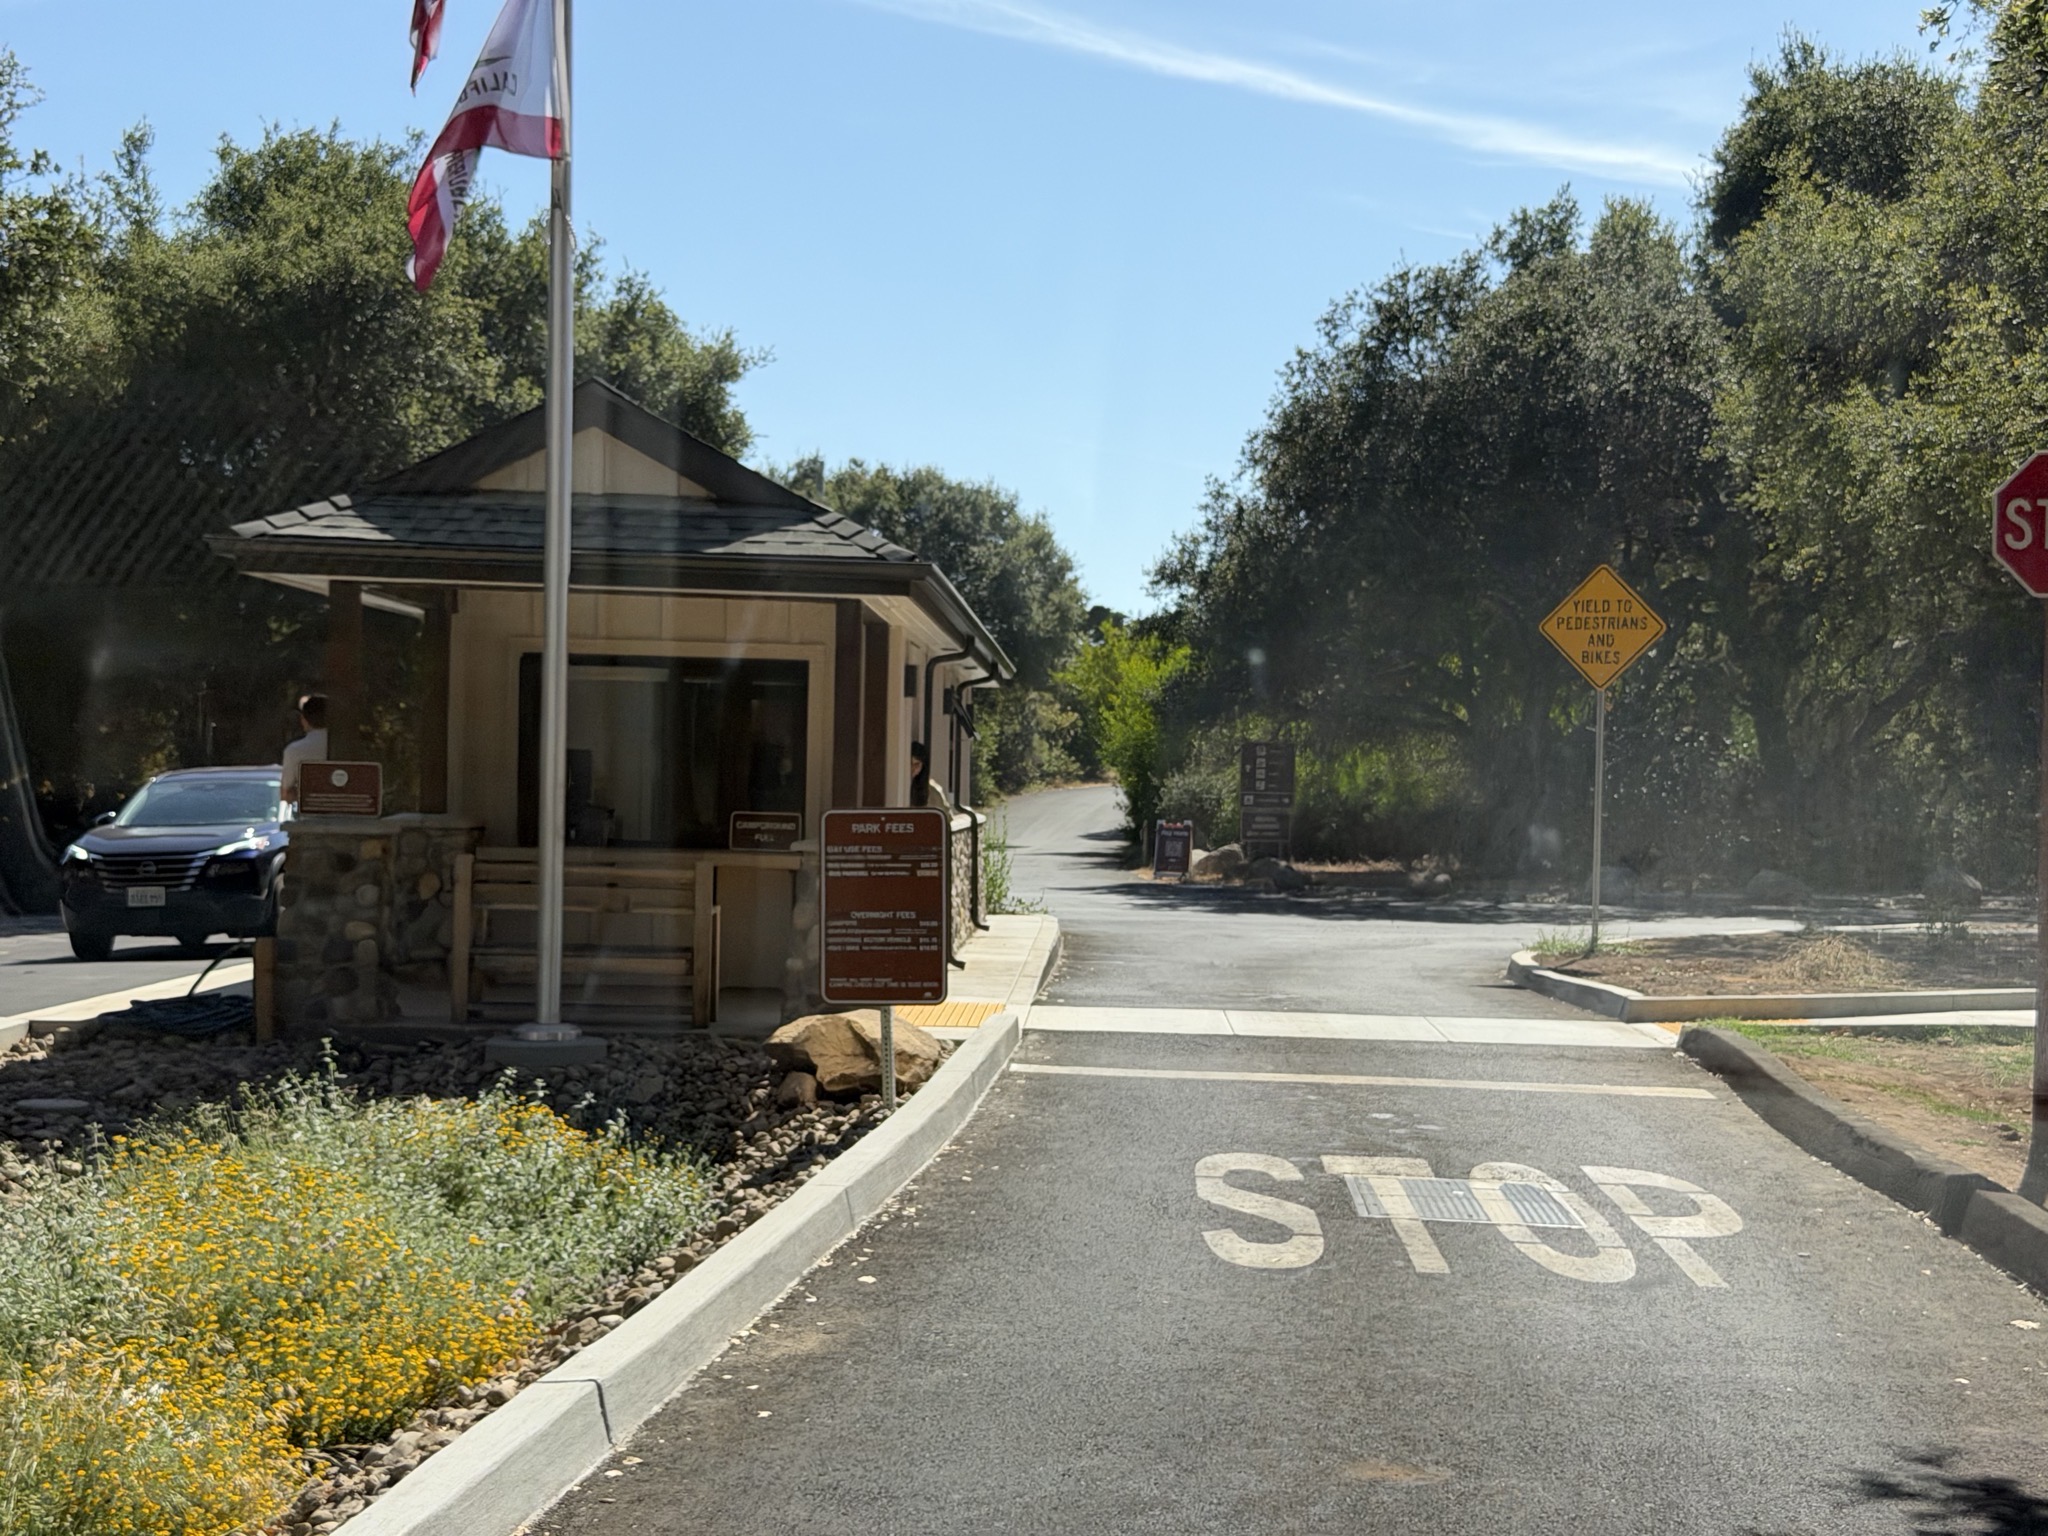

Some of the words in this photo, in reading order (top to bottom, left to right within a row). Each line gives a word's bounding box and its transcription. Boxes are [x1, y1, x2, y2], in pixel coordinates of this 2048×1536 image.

[1573, 599, 1611, 613] YIELD
[1617, 599, 1633, 613] TO
[1556, 616, 1648, 630] PEDESTRIANS
[1587, 633, 1615, 647] AND
[1581, 650, 1620, 664] BIKES
[851, 823, 881, 834] PARK
[885, 823, 915, 834] FEES
[850, 911, 894, 919] OVERNIGHT
[896, 911, 917, 919] FEES
[1194, 1152, 1743, 1288] STOP
